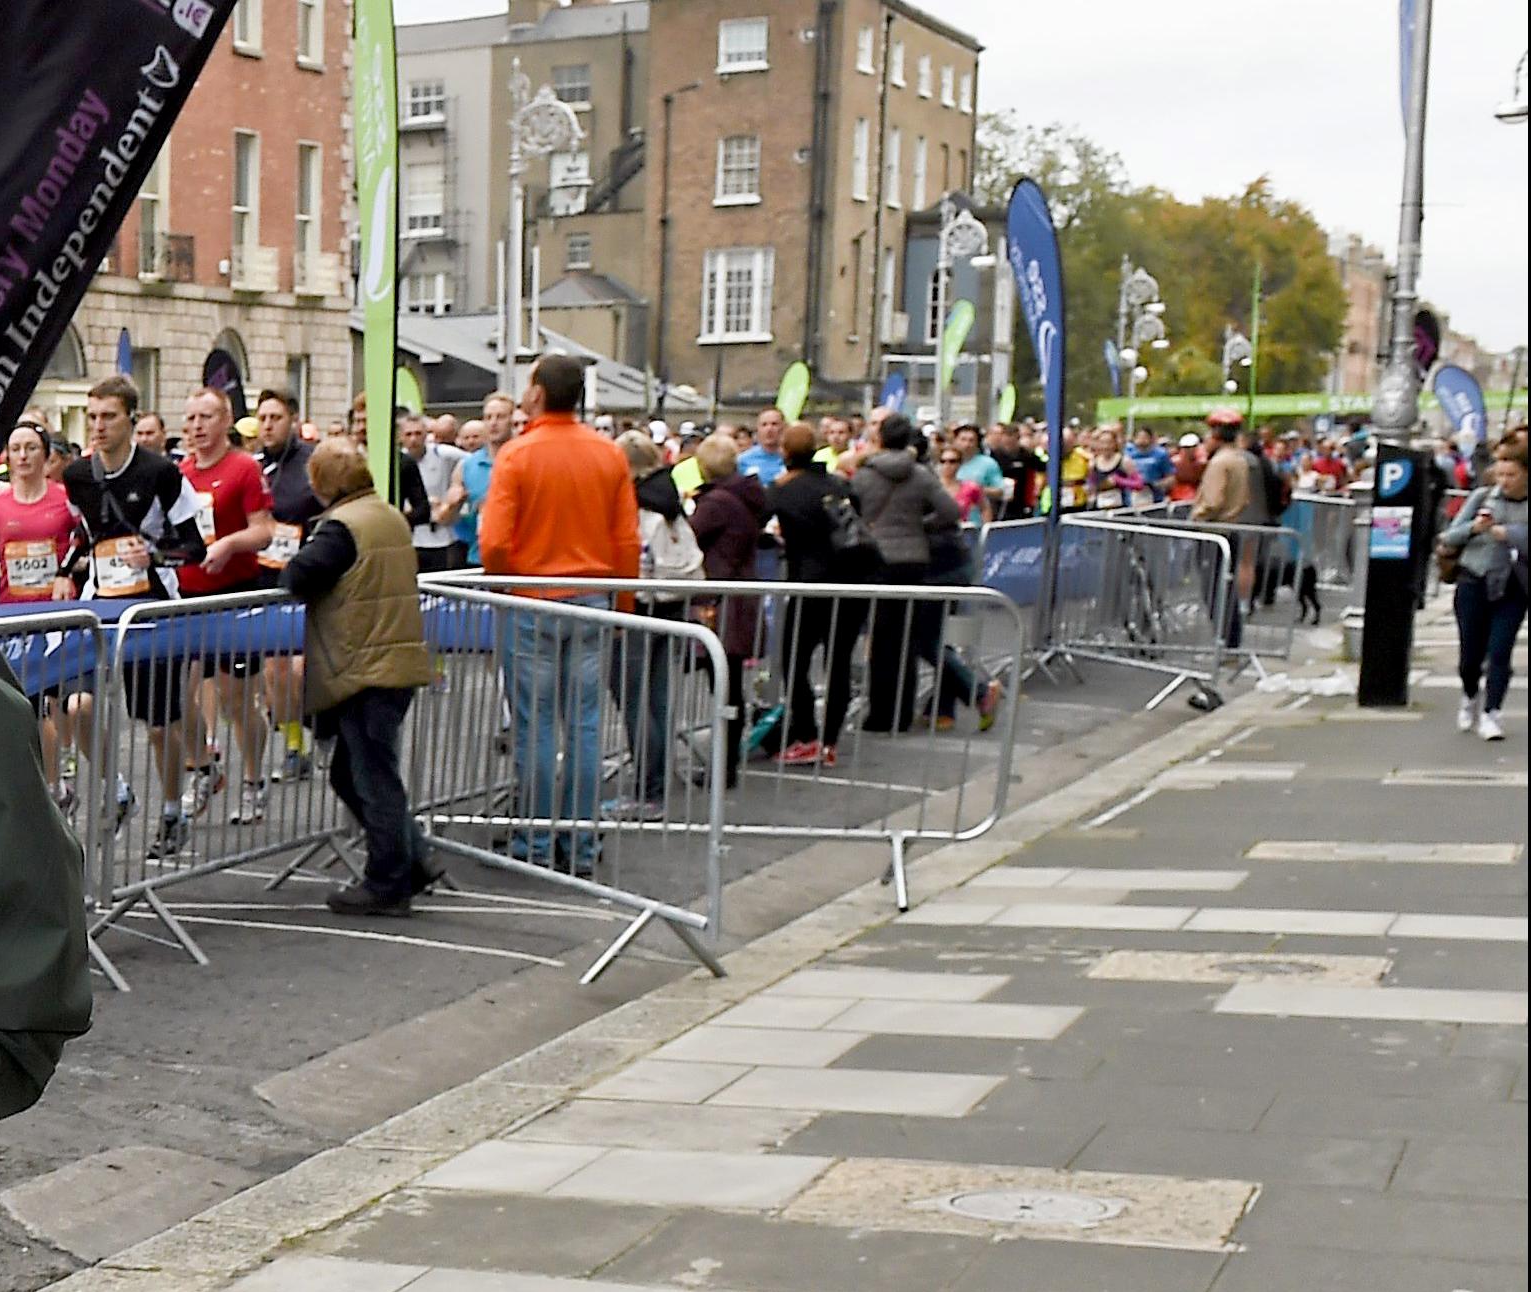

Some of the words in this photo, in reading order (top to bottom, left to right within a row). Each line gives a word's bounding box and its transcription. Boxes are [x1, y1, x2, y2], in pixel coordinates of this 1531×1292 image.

[7, 88, 165, 351] Independent
[10, 88, 111, 243] Monday
[1381, 462, 1404, 490] P
